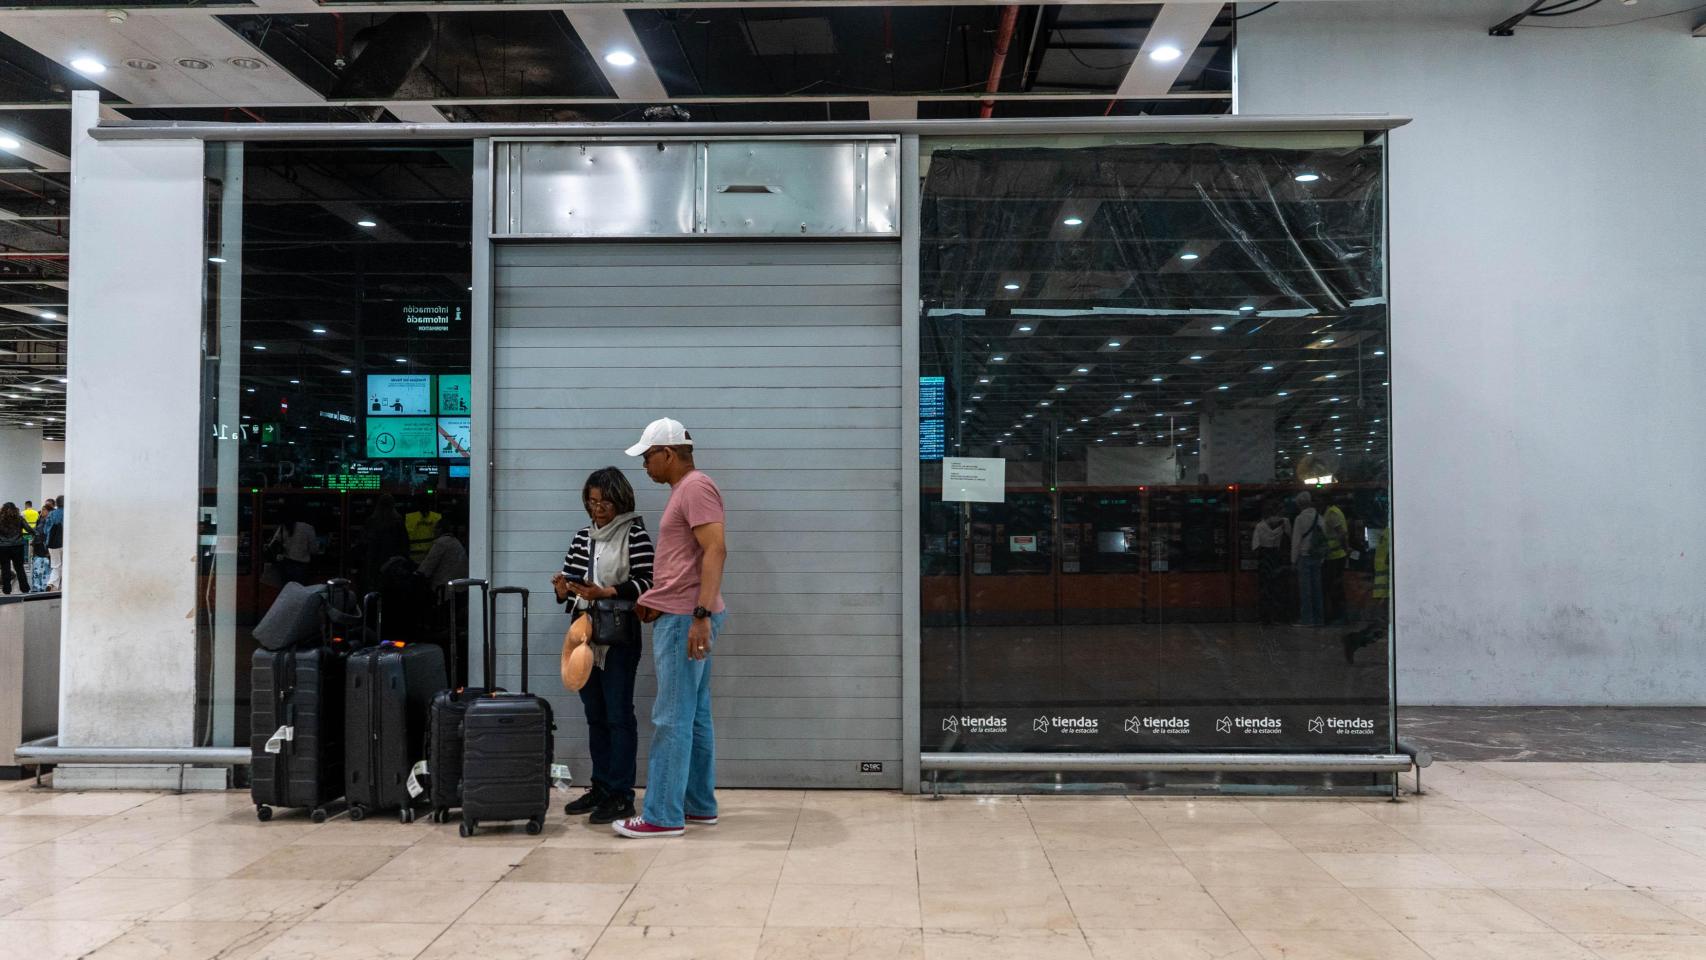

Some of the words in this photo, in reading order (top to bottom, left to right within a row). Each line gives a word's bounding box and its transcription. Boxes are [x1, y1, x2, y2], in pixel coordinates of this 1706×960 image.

[961, 716, 1007, 727] tiendas
[1052, 716, 1098, 727] tiendas
[1144, 716, 1189, 727] tiendas
[1235, 717, 1281, 727] tiendas
[1327, 717, 1373, 727] tiendas
